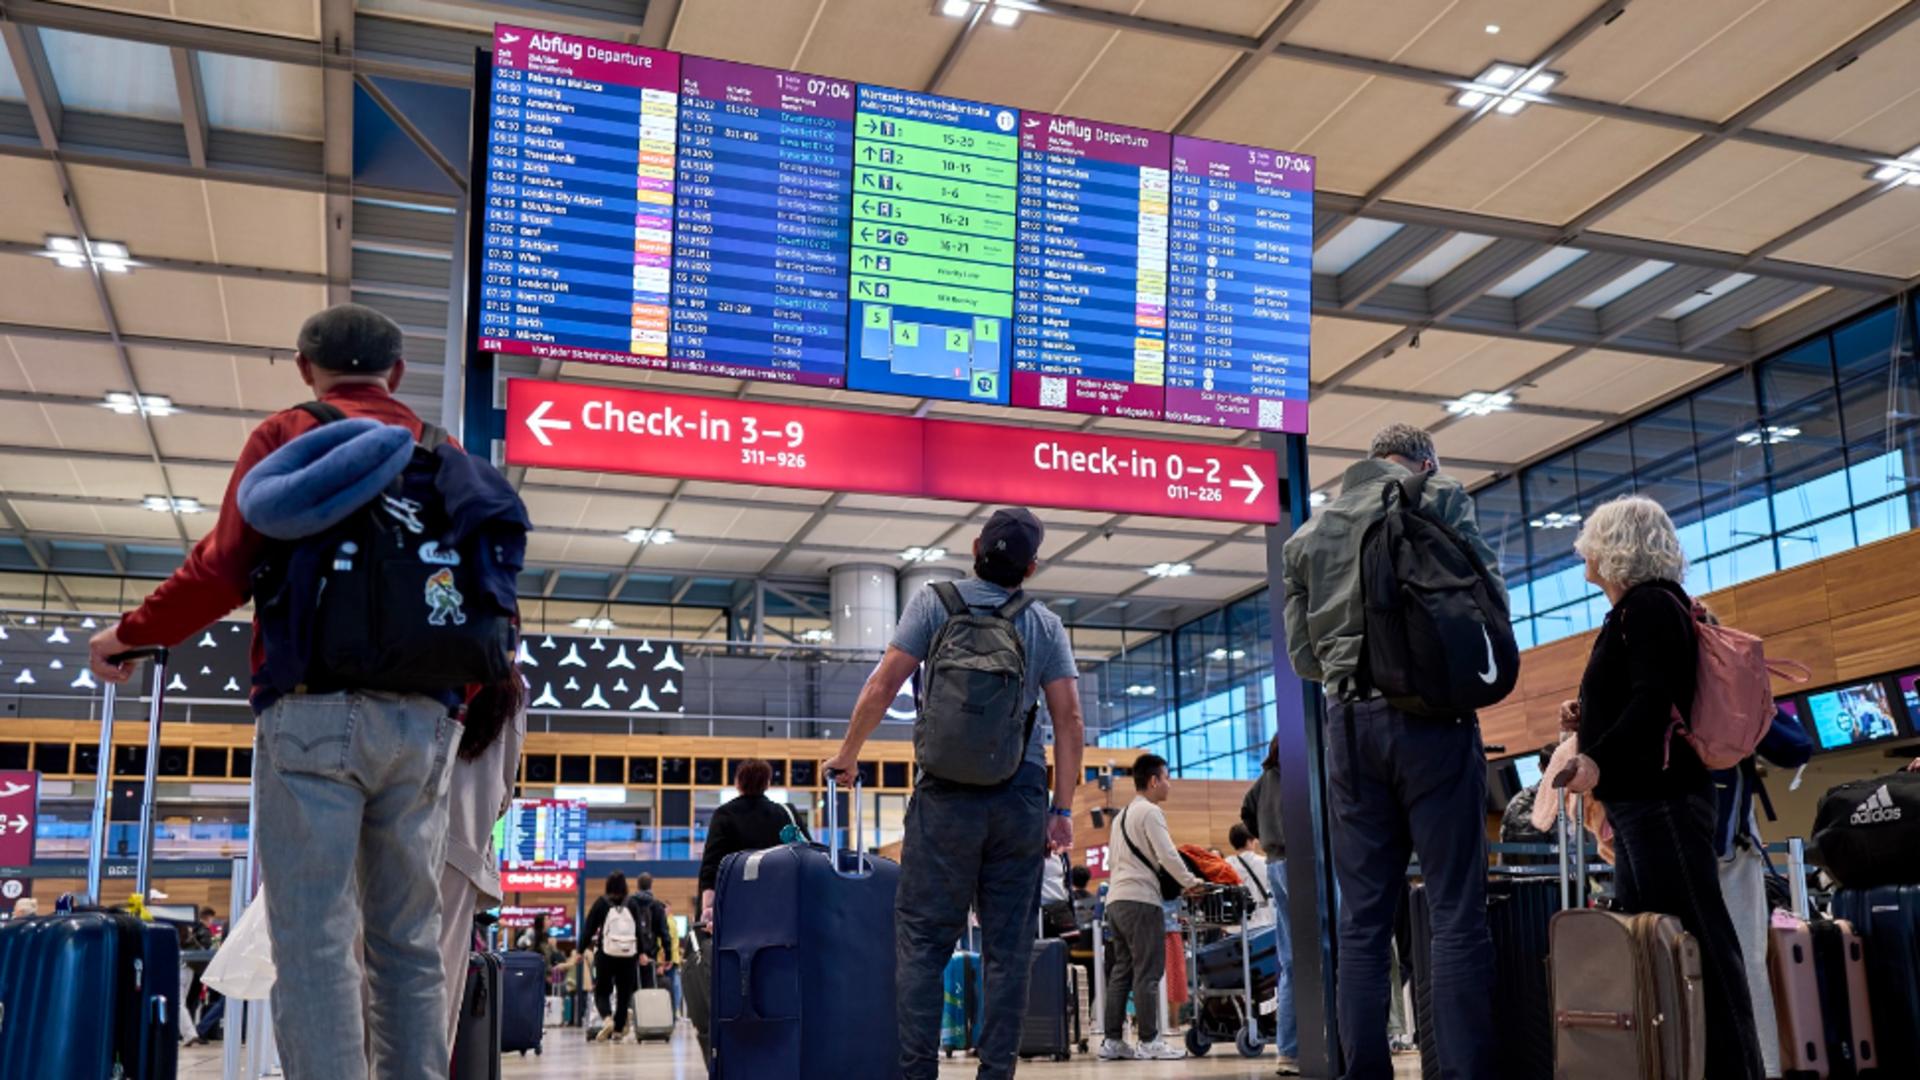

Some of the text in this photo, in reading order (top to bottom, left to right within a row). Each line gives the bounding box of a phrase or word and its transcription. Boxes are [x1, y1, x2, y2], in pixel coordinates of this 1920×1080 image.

[528, 34, 651, 68] Abflug Departure
[527, 72, 602, 91] Palma de Mallorca
[776, 74, 782, 88] 1
[807, 79, 850, 98] 07:04
[525, 98, 574, 112] Amsterdam
[887, 104, 905, 113] Time
[906, 106, 932, 118] Security
[905, 95, 990, 117] Sicherheitskontrolle
[525, 110, 561, 123] Lissabon
[525, 123, 553, 135] Dublin
[1048, 119, 1148, 147] Abflug Departure
[523, 135, 545, 147] Paris
[942, 133, 974, 147] 15-20
[524, 149, 574, 164] Thessaloniki
[895, 153, 903, 164] 2
[942, 159, 971, 173] 10-15
[1248, 150, 1255, 163] 3
[1275, 155, 1310, 172] 07:04
[522, 175, 562, 188] Frankfurt
[521, 187, 602, 206] London City Airport
[895, 208, 901, 218] 5
[940, 212, 969, 226] 16-21
[519, 238, 558, 252] Stuttgart
[518, 252, 541, 262] Wien
[1044, 258, 1065, 268] Palma
[517, 264, 539, 275] Paris
[517, 278, 549, 289] London
[515, 303, 539, 314] Basel
[873, 311, 881, 323] 5
[515, 329, 555, 342] München
[901, 329, 910, 340] 4
[984, 323, 989, 335] 1
[952, 333, 961, 346] 2
[581, 400, 804, 448] Check-in 3–9
[741, 448, 806, 468] 311–926
[1034, 442, 1222, 483] Check-in 0–2
[1167, 484, 1222, 502] 011–226
[1850, 807, 1901, 824] adidas
